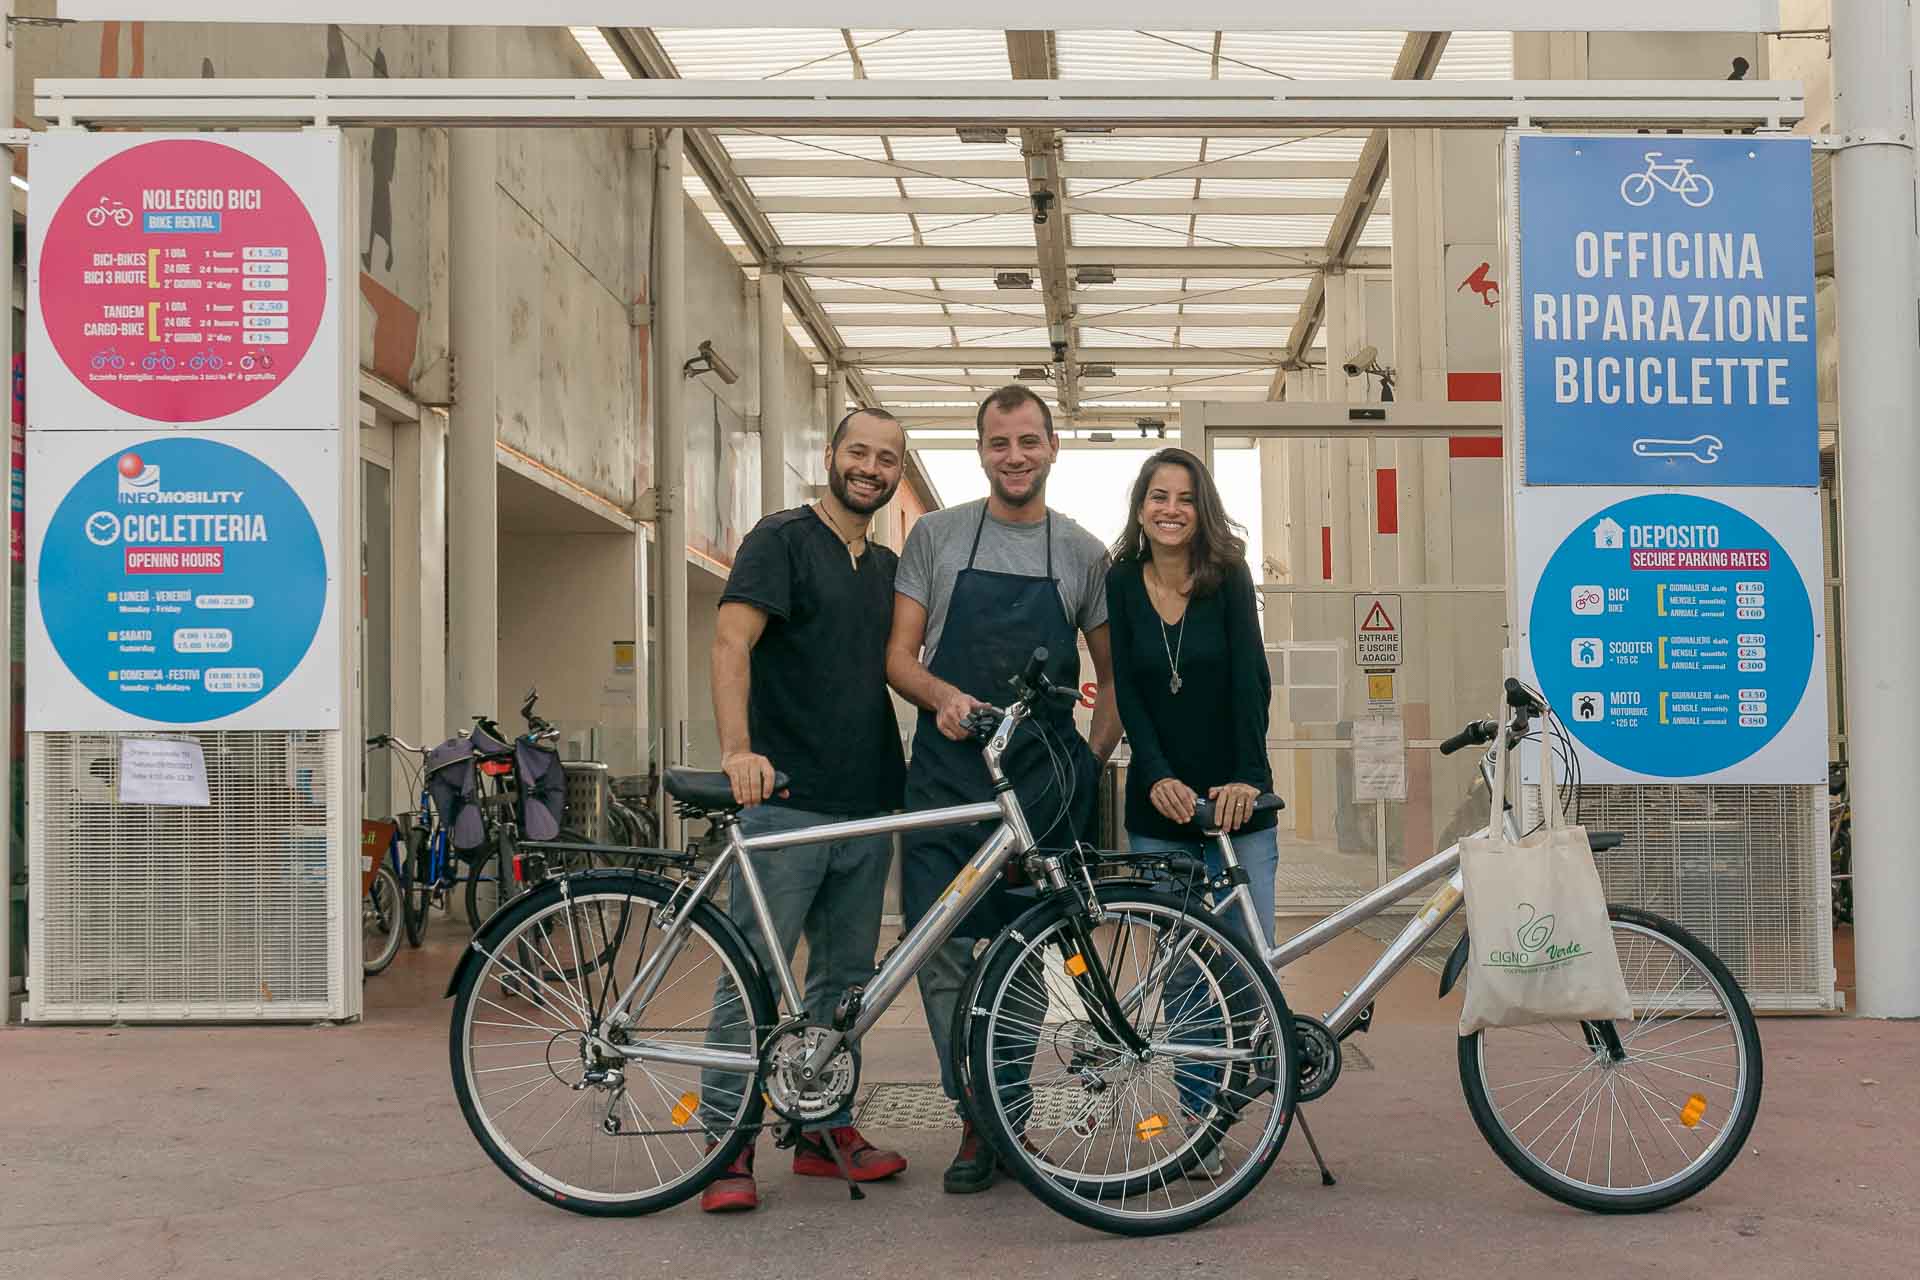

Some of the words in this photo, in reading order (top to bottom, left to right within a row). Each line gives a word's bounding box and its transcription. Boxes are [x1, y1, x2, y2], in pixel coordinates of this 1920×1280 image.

[143, 189, 224, 210] NOLEGGIO
[228, 189, 262, 210] BICI
[148, 216, 173, 228] BIKE
[175, 216, 215, 228] RENTAL
[93, 253, 146, 266] BICI-BIKES
[1575, 232, 1764, 280] OFFICINA
[84, 271, 104, 284] BICI
[105, 271, 113, 284] 3
[114, 271, 146, 284] RUOTE
[104, 306, 144, 318] TANDEM
[1533, 294, 1809, 342] RIPARAZIONE
[84, 322, 144, 336] CARGO-BIKE
[1554, 356, 1790, 406] BICICLETTE
[118, 492, 244, 504] INFOMOBILITY
[123, 514, 268, 542] CICLETTERIA
[1630, 525, 1720, 548] DEPOSITO
[128, 552, 179, 568] OPENING
[181, 552, 222, 568] HOURS
[1633, 552, 1676, 567] SECURE
[1678, 552, 1728, 567] PARKING
[1731, 552, 1768, 567] RATES
[1608, 588, 1629, 601] BICI
[1608, 604, 1623, 612] BIKE
[1359, 634, 1399, 642] ENTRARE
[1367, 644, 1399, 652] USCIRE
[1609, 642, 1653, 654] SCOOTER
[1362, 654, 1396, 662] ADAGIO
[1630, 656, 1638, 664] CC
[1610, 692, 1641, 705] MOTO
[1629, 718, 1638, 728] CC
[1546, 940, 1583, 960] Verde
[1490, 951, 1529, 964] CIGNO
